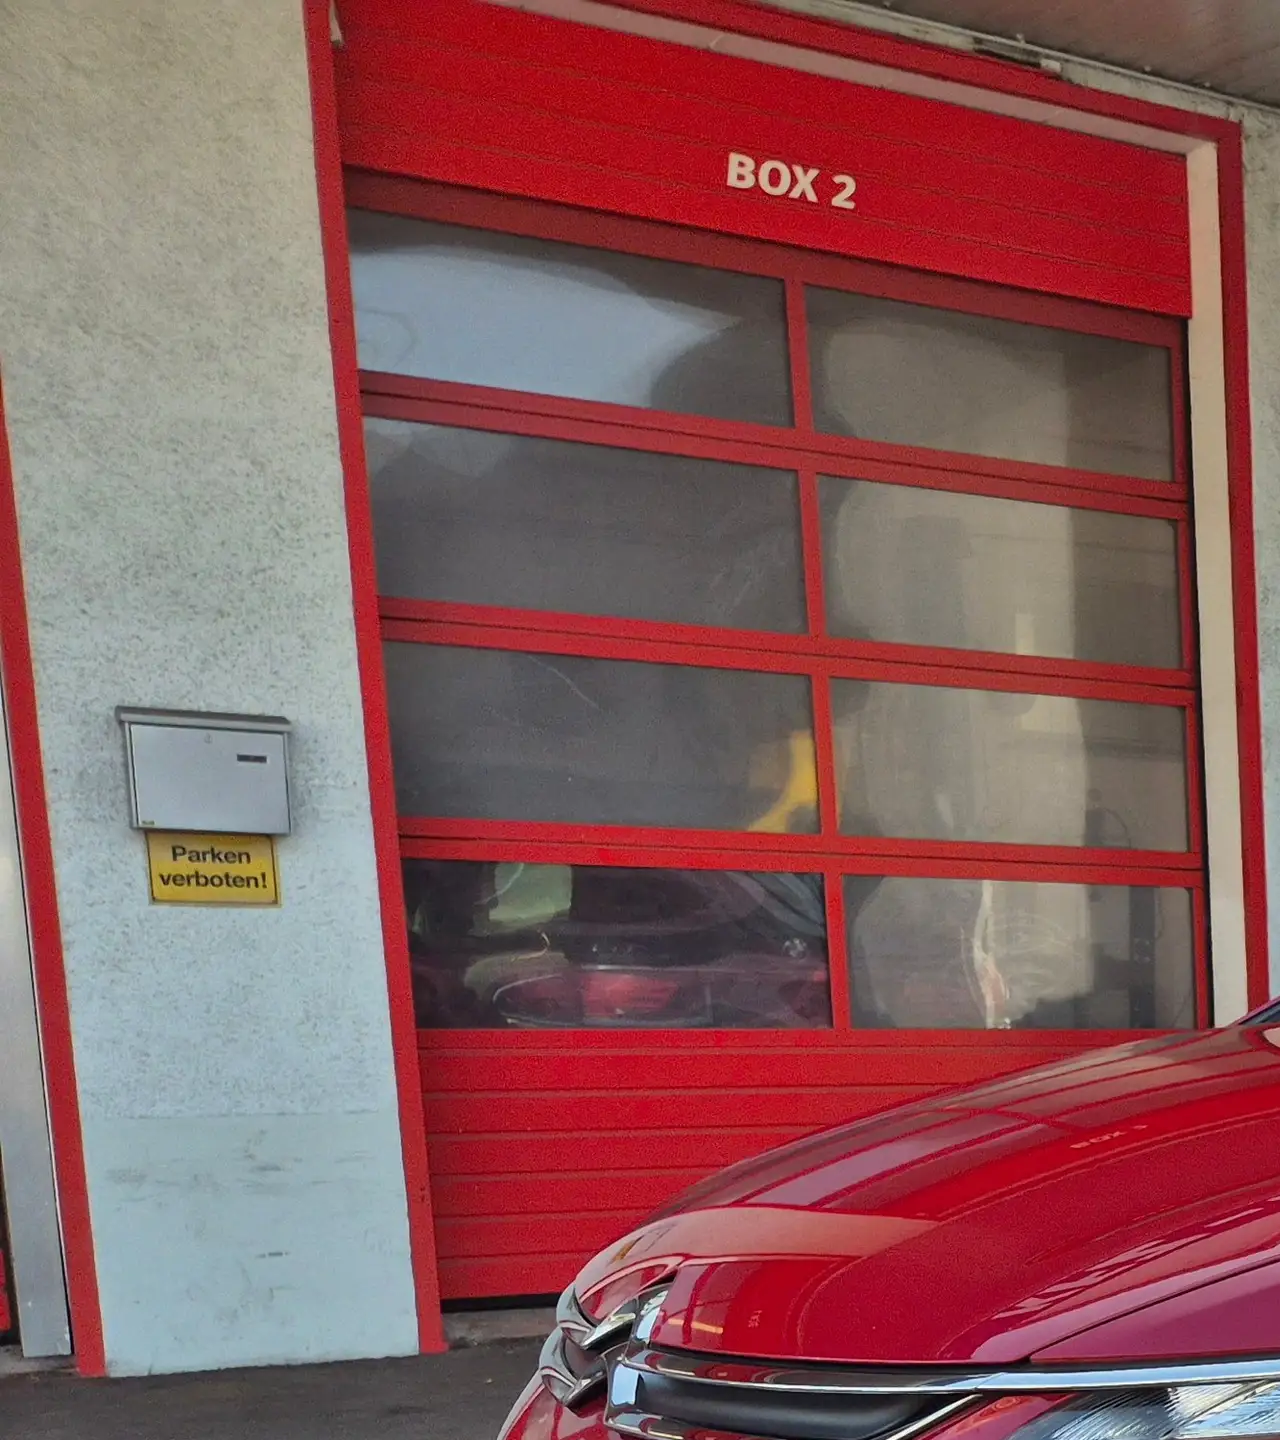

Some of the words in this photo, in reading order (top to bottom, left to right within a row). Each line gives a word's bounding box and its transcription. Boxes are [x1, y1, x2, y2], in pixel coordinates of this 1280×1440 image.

[726, 151, 821, 204] BOX
[831, 173, 857, 210] 2
[171, 844, 251, 865] Parken
[158, 871, 268, 890] verboten!
